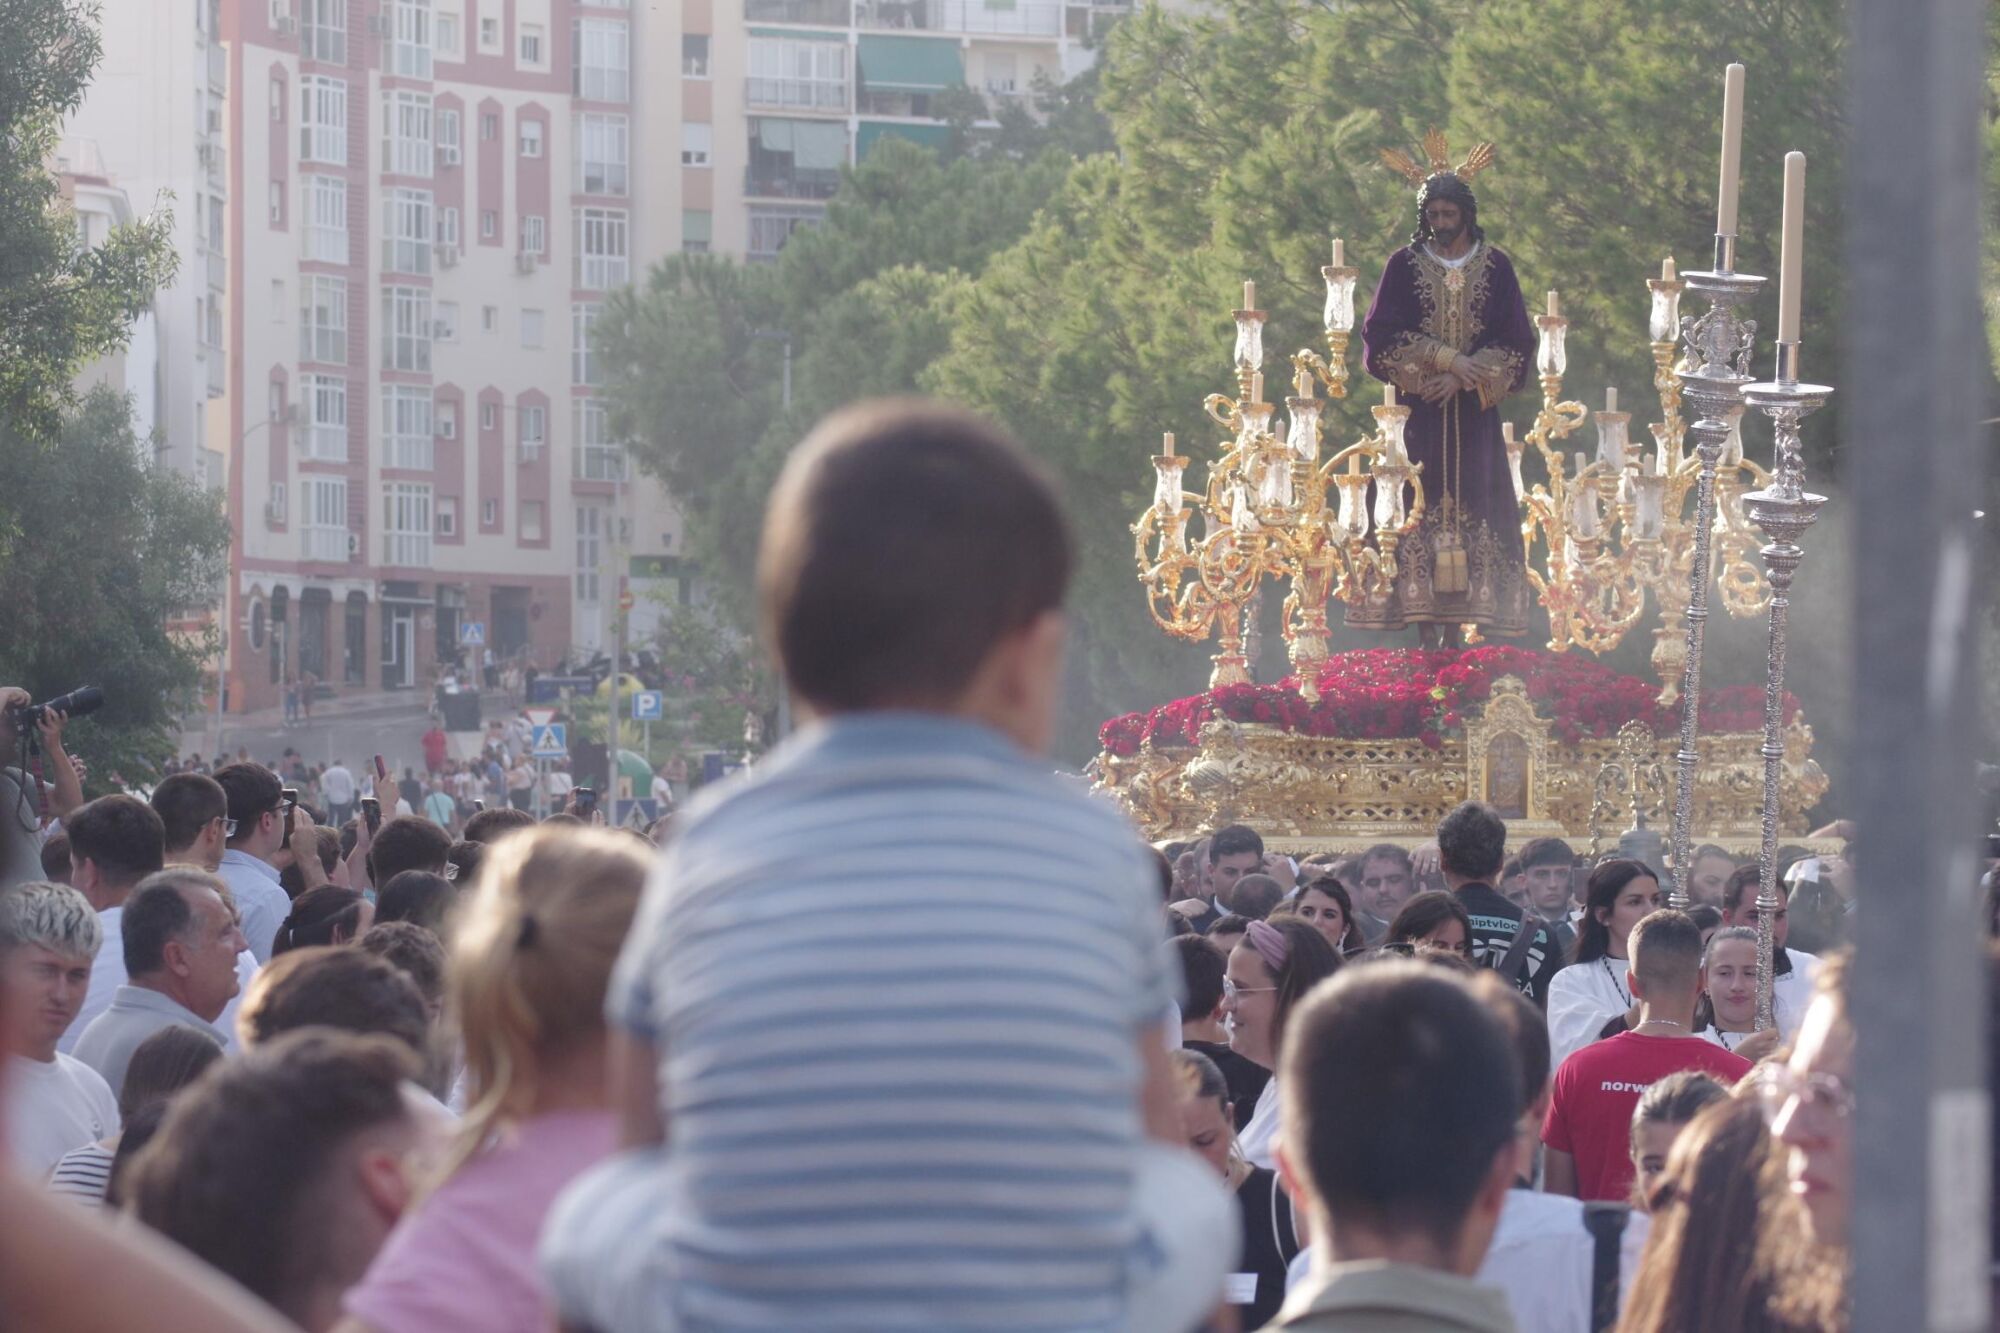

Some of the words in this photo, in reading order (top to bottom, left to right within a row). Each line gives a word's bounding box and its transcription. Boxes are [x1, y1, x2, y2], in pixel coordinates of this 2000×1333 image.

[638, 694, 656, 717] P
[1471, 917, 1521, 931] iptvloc
[1601, 1081, 1649, 1093] norw
